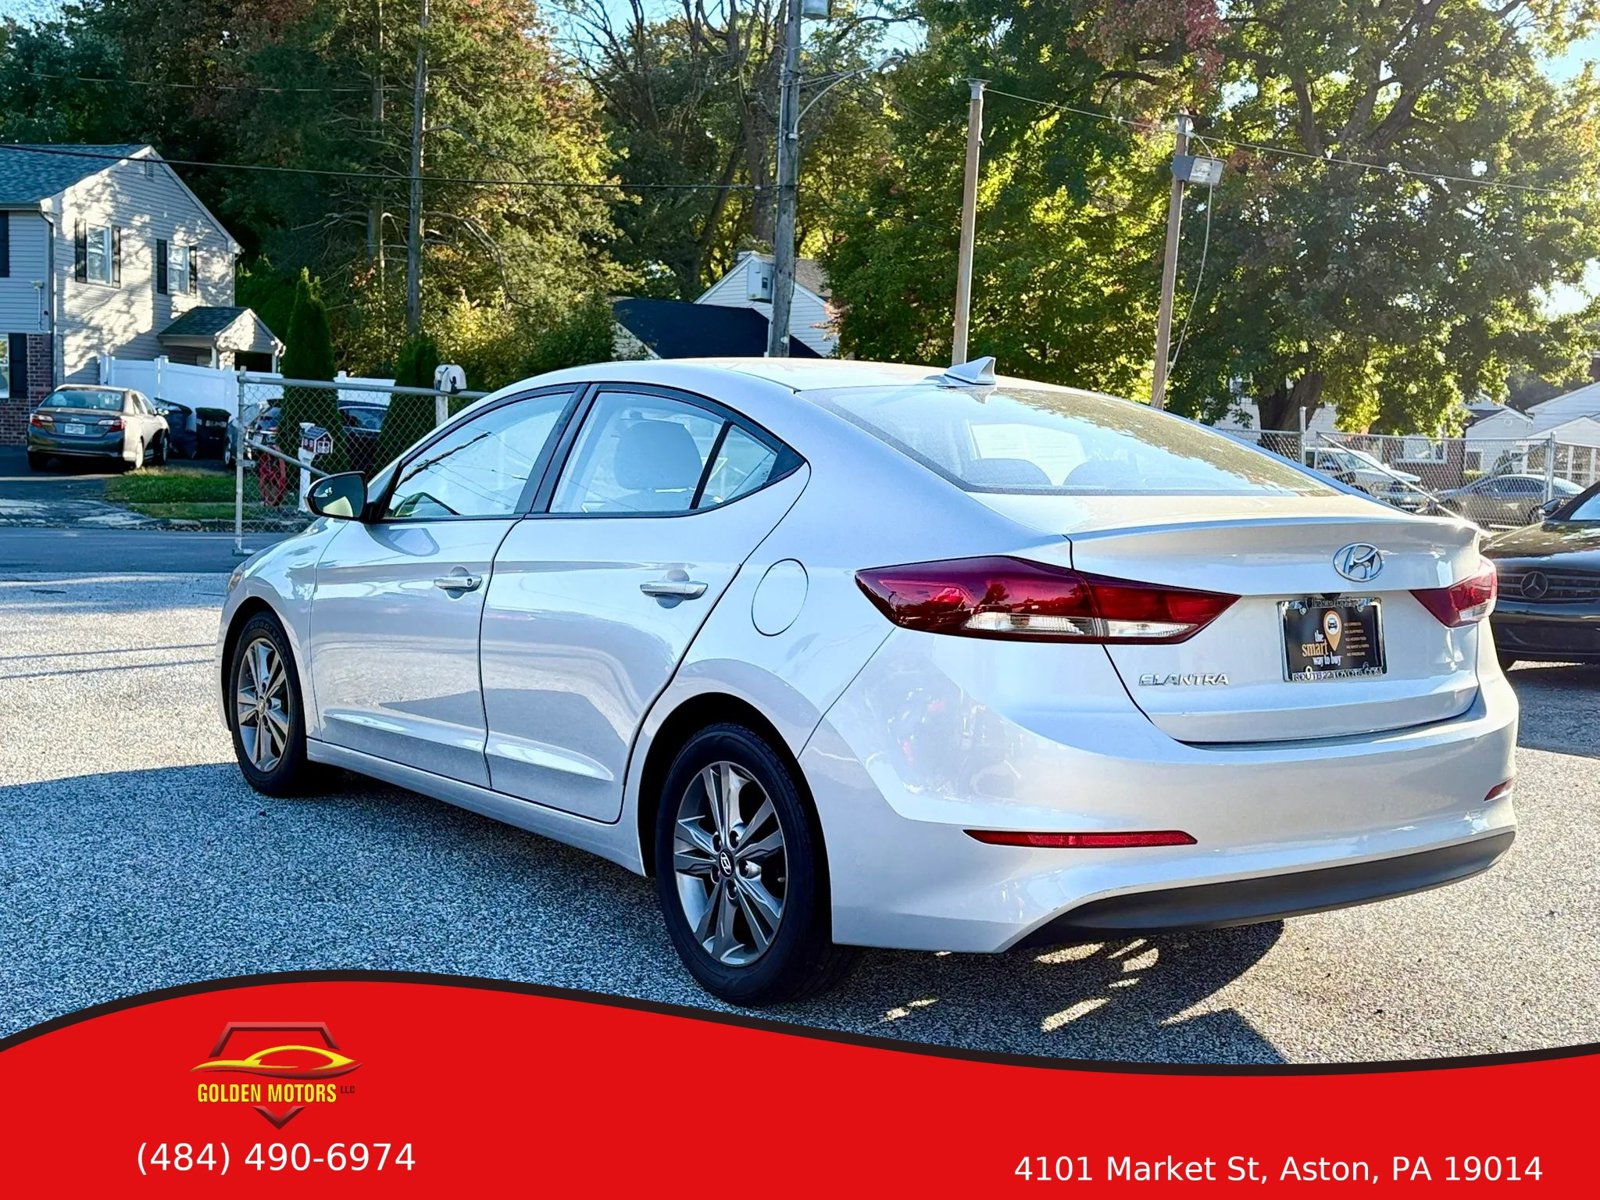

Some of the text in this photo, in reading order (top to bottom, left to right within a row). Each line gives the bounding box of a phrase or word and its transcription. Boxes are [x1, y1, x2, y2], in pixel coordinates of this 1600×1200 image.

[1314, 630, 1324, 642] the
[1302, 640, 1328, 656] smart
[1312, 656, 1324, 667] way
[1325, 653, 1330, 665] to
[1330, 652, 1342, 666] buy
[1139, 672, 1230, 686] ELANTRA
